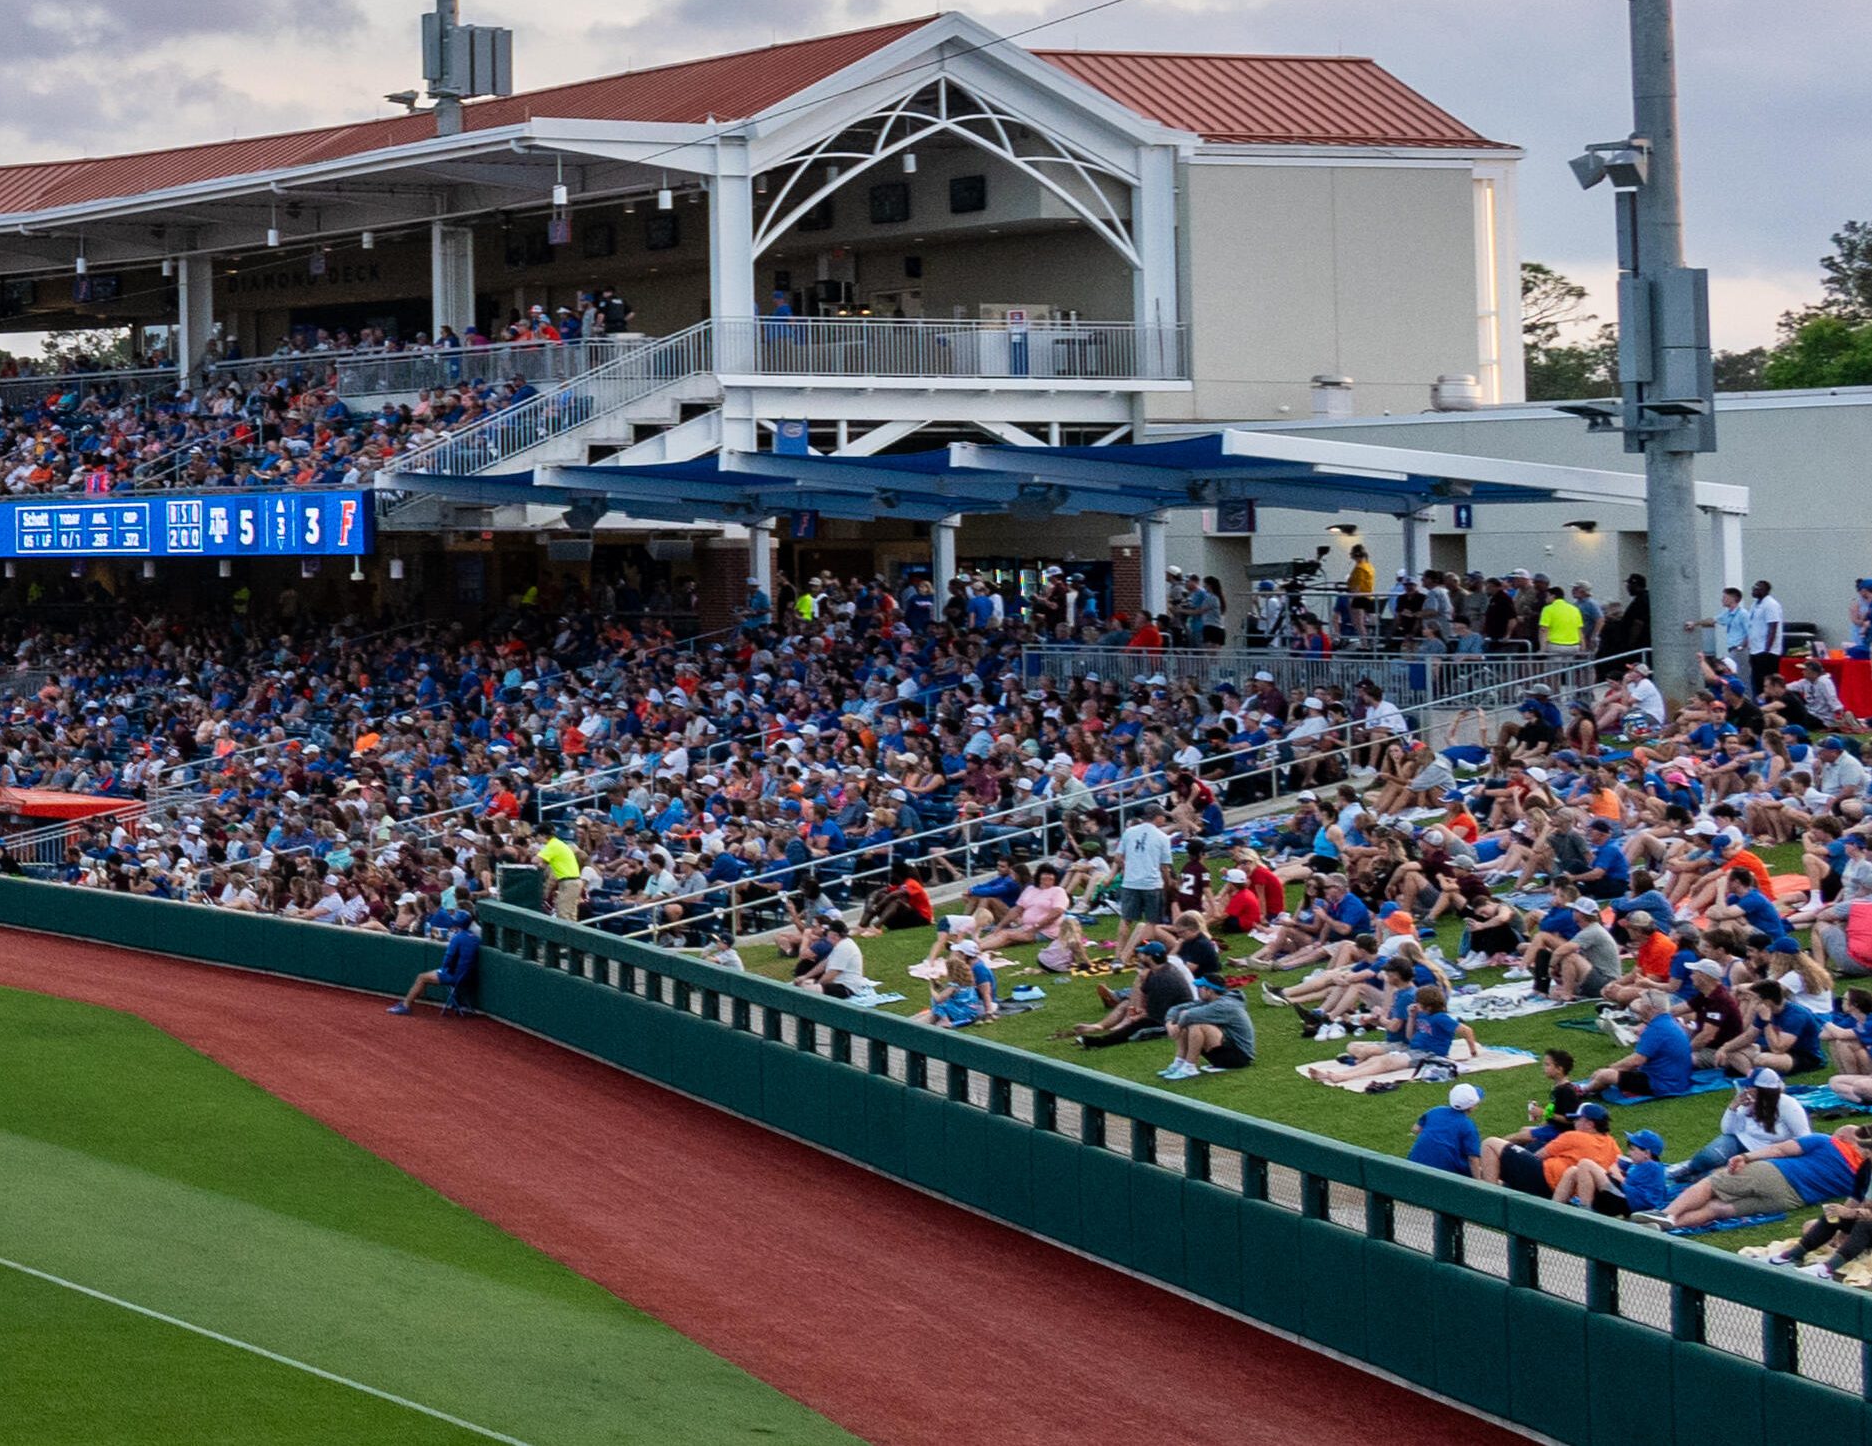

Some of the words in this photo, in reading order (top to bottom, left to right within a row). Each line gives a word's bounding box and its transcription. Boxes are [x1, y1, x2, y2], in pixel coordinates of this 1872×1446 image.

[239, 509, 254, 545] 5
[277, 516, 286, 535] 3
[304, 507, 320, 544] 3
[338, 500, 356, 546] F
